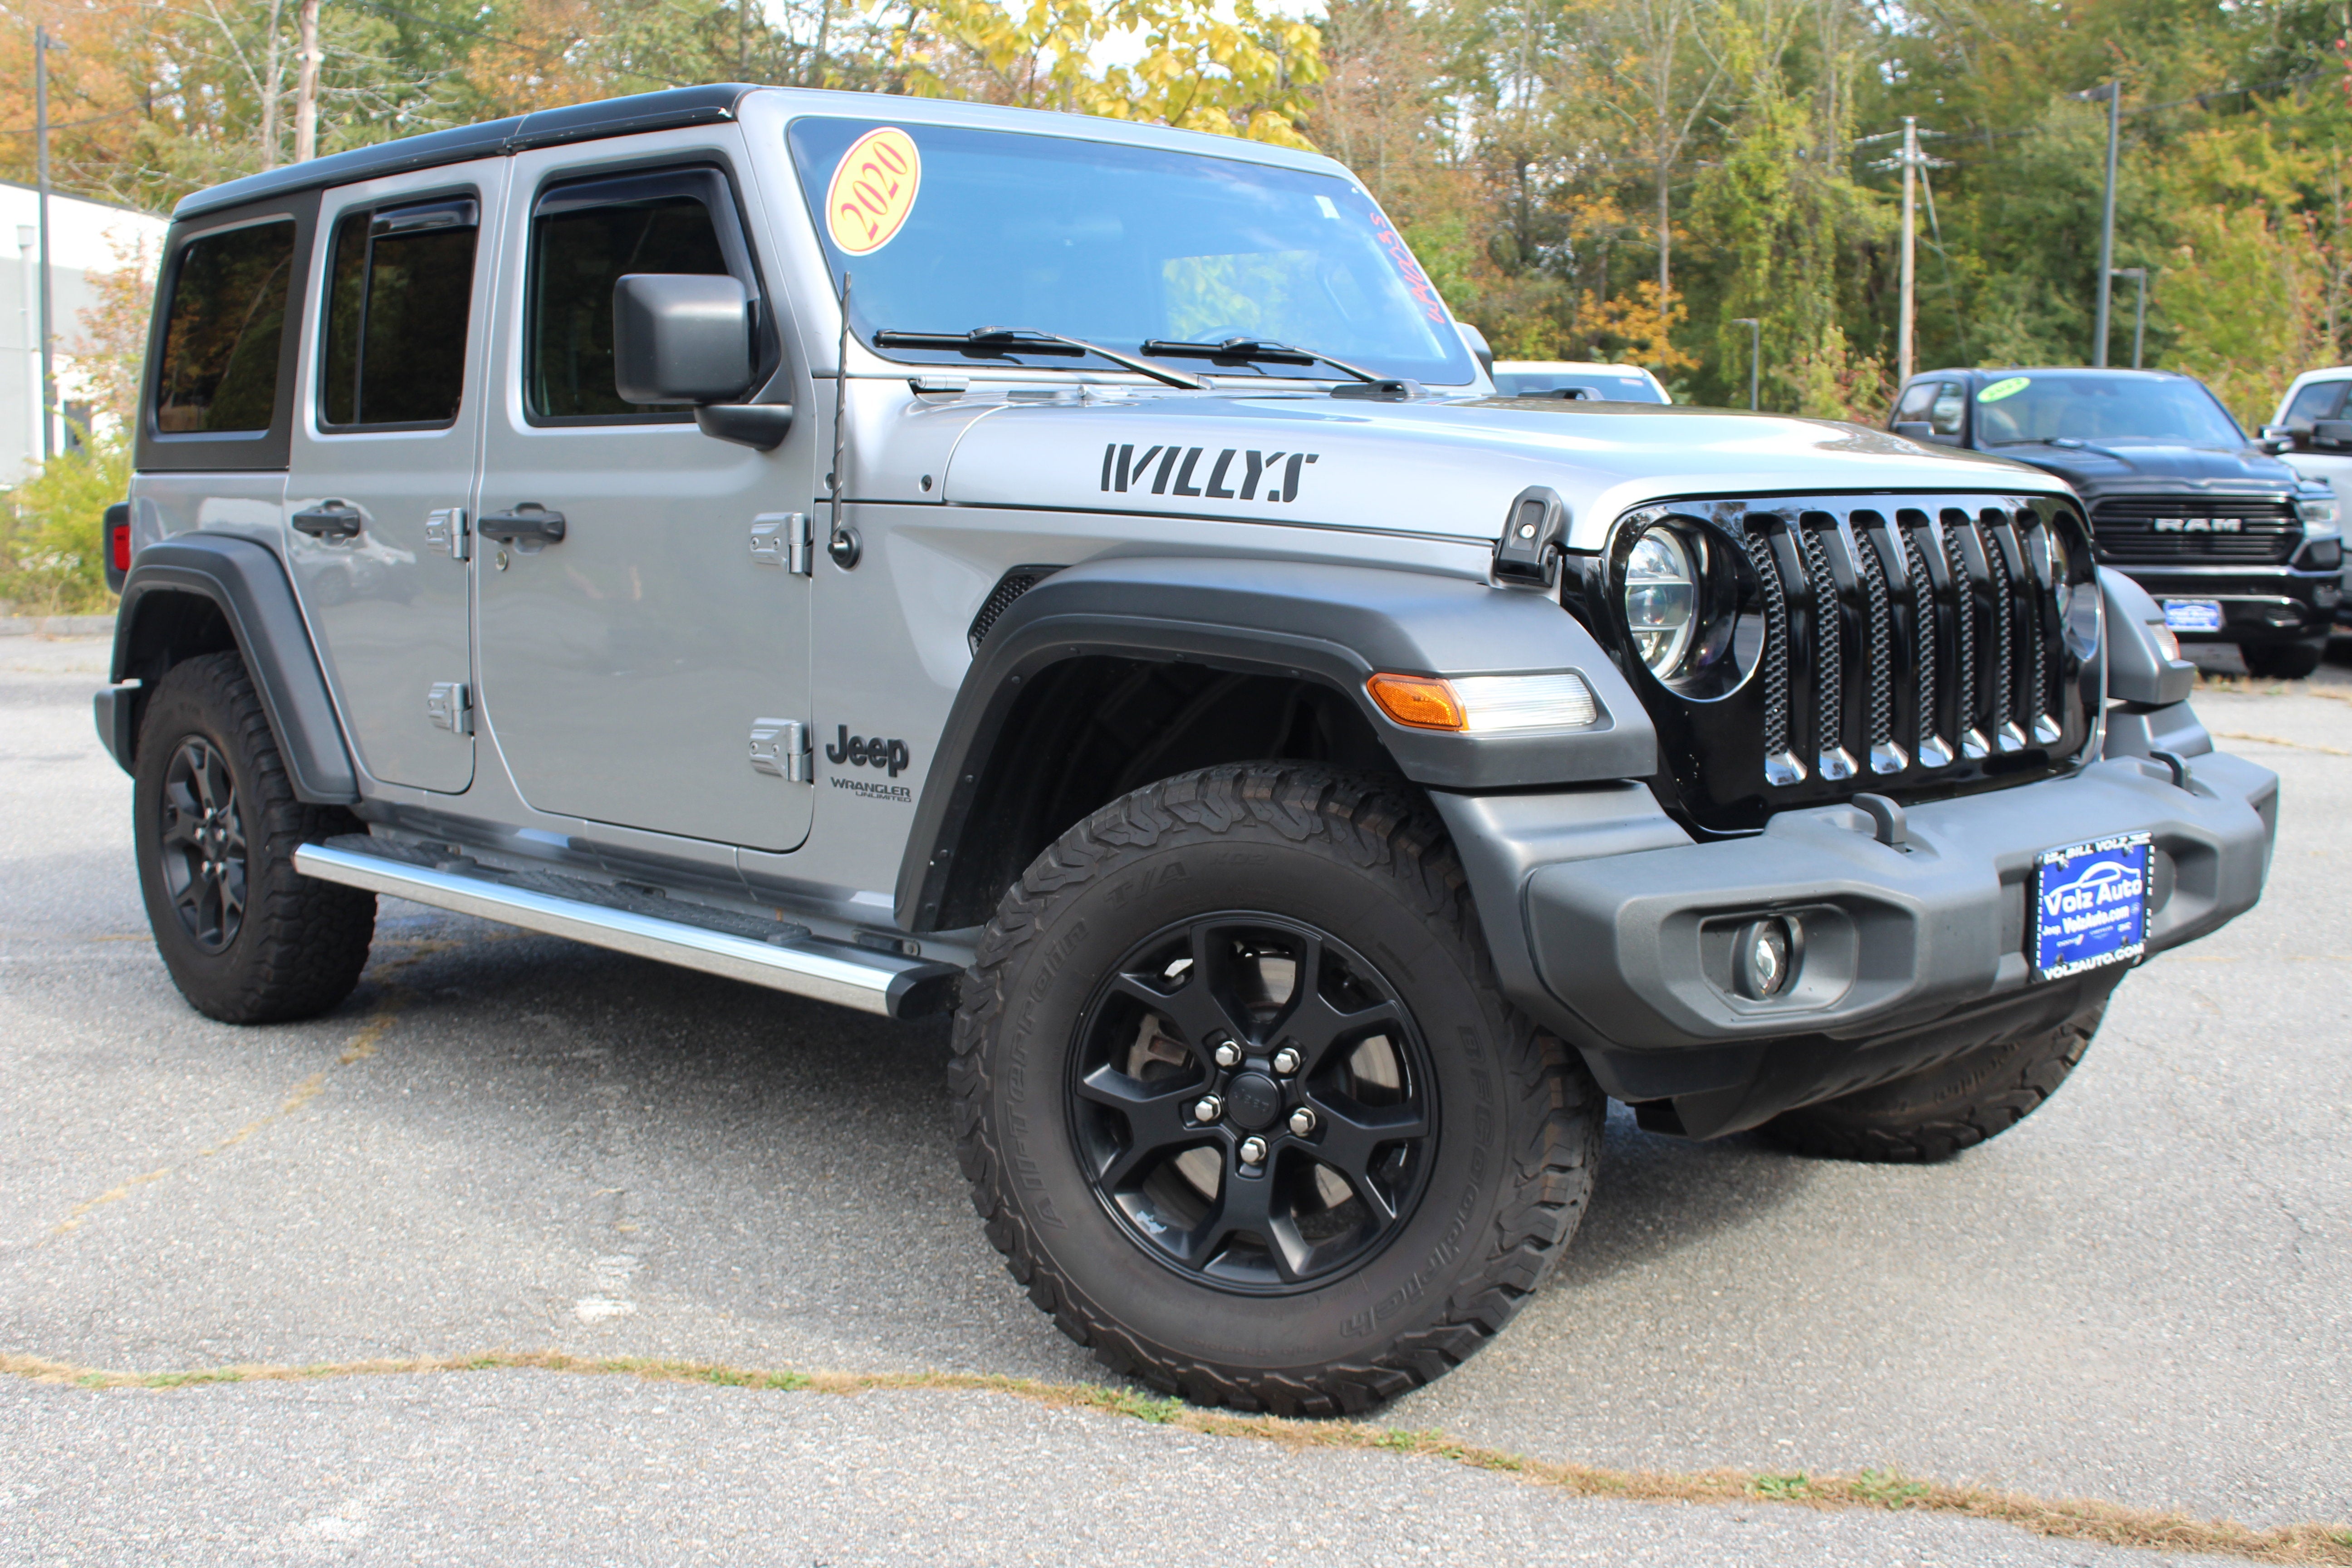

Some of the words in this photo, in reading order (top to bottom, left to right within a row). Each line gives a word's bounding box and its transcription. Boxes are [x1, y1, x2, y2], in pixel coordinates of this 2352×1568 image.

[841, 142, 907, 242] 2020
[1101, 443, 1319, 503] WILLYS
[2155, 518, 2242, 532] RAM
[826, 725, 910, 777] Jeep
[831, 776, 911, 797] WRANGLER
[855, 791, 911, 803] UNLIMITED
[2065, 844, 2094, 859] BILL
[2094, 836, 2128, 852] VOLZ
[1104, 862, 1192, 908] T/A
[2043, 889, 2093, 916] Volz
[2096, 879, 2143, 905] Auto
[2062, 905, 2130, 934] VolzAuto.com
[2043, 942, 2145, 980] VOLZAUTO.COM
